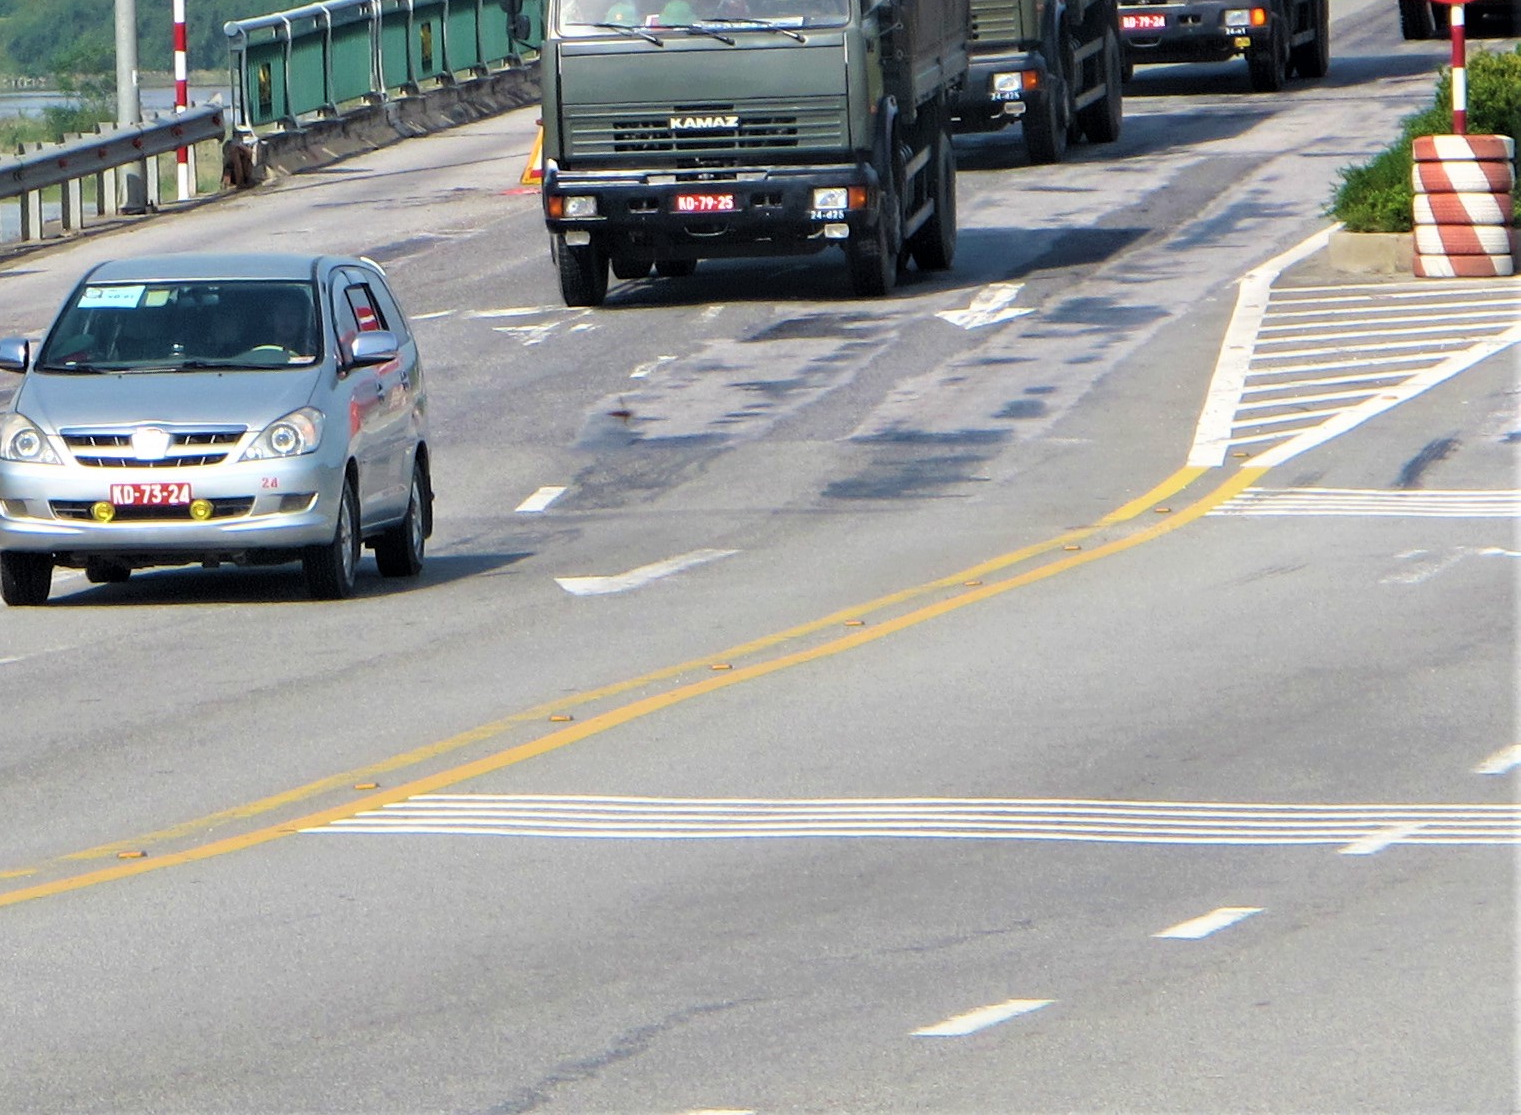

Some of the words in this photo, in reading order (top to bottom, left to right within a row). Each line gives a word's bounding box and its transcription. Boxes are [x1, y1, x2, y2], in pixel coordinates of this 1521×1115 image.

[670, 116, 739, 130] KAMAZ
[678, 195, 734, 211] KD-79-25
[112, 484, 191, 505] KD-73-24
